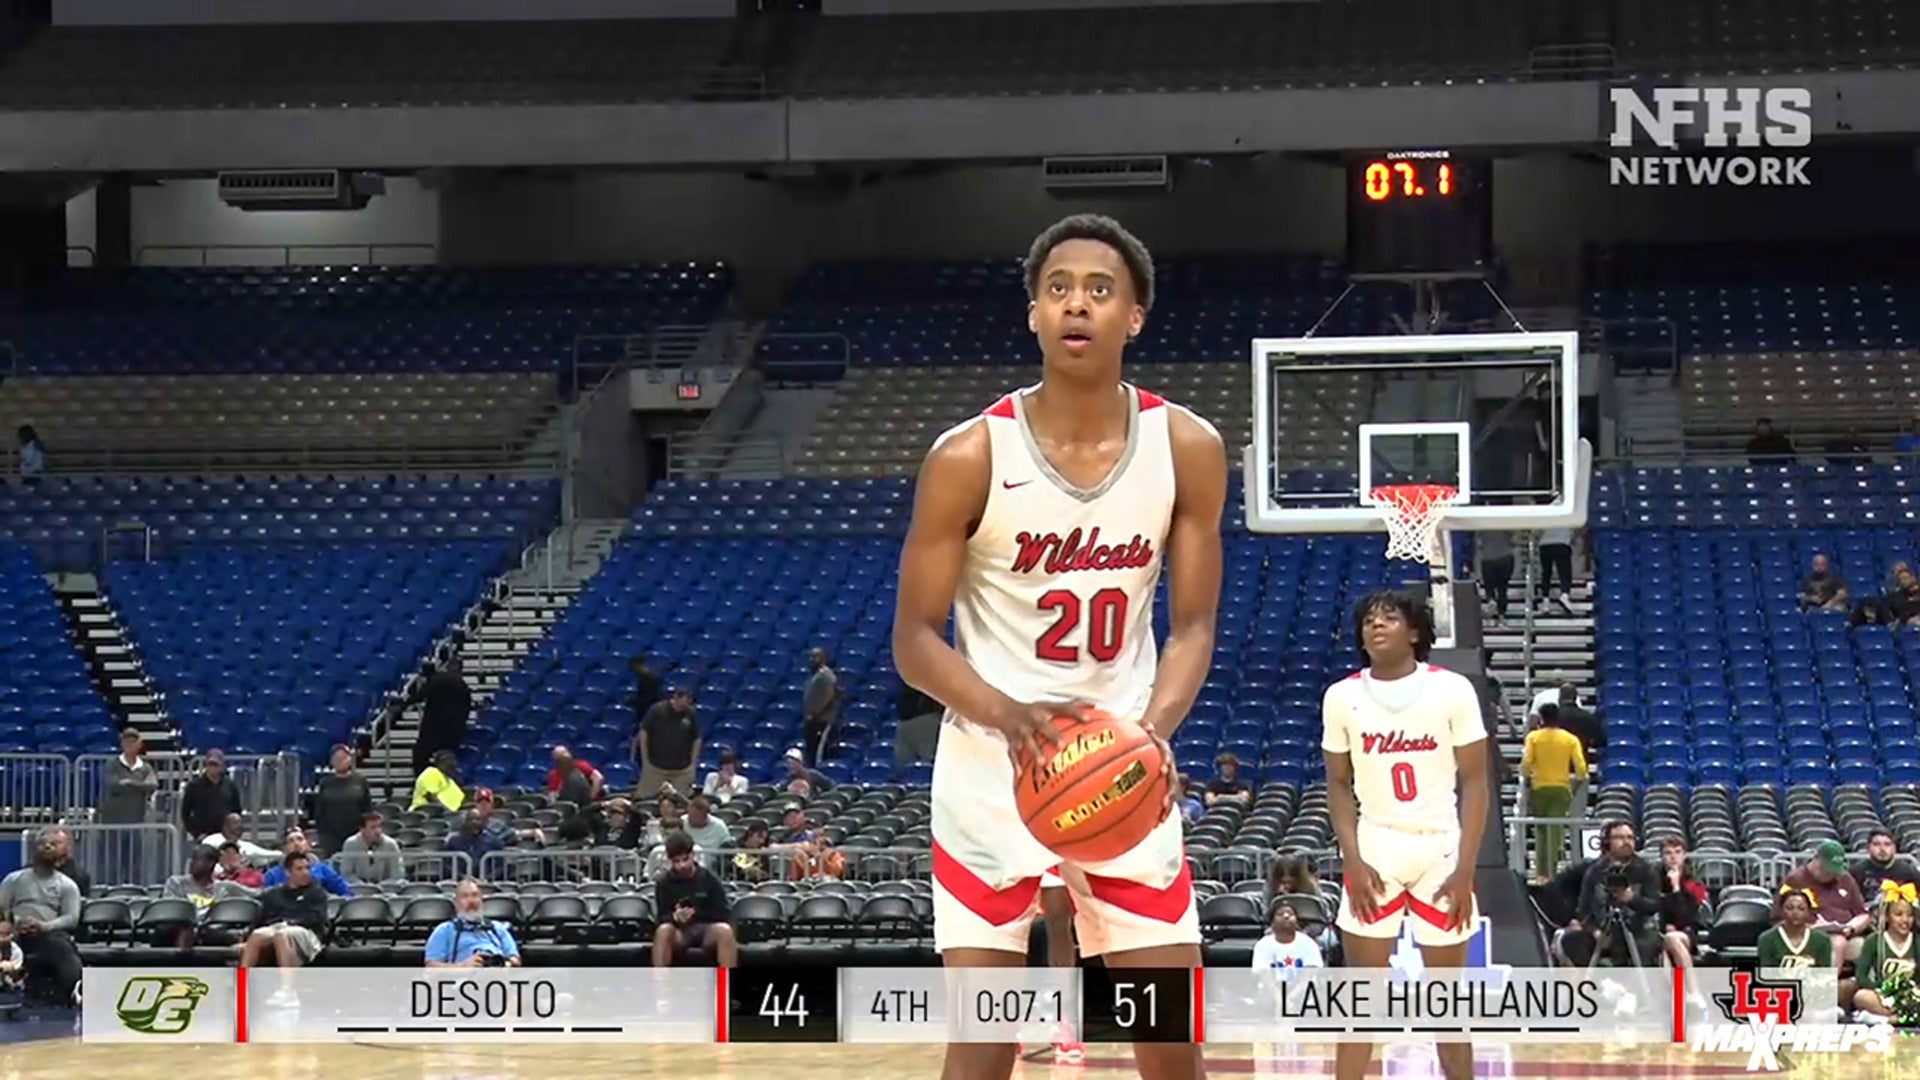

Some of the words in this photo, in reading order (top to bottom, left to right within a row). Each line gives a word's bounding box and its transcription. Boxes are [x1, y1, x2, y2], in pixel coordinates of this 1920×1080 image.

[1365, 162, 1450, 200] 07.1
[1011, 526, 1154, 575] Wildcats
[1035, 587, 1129, 663] 20
[1360, 729, 1439, 755] Wildcats
[1391, 761, 1418, 802] 0
